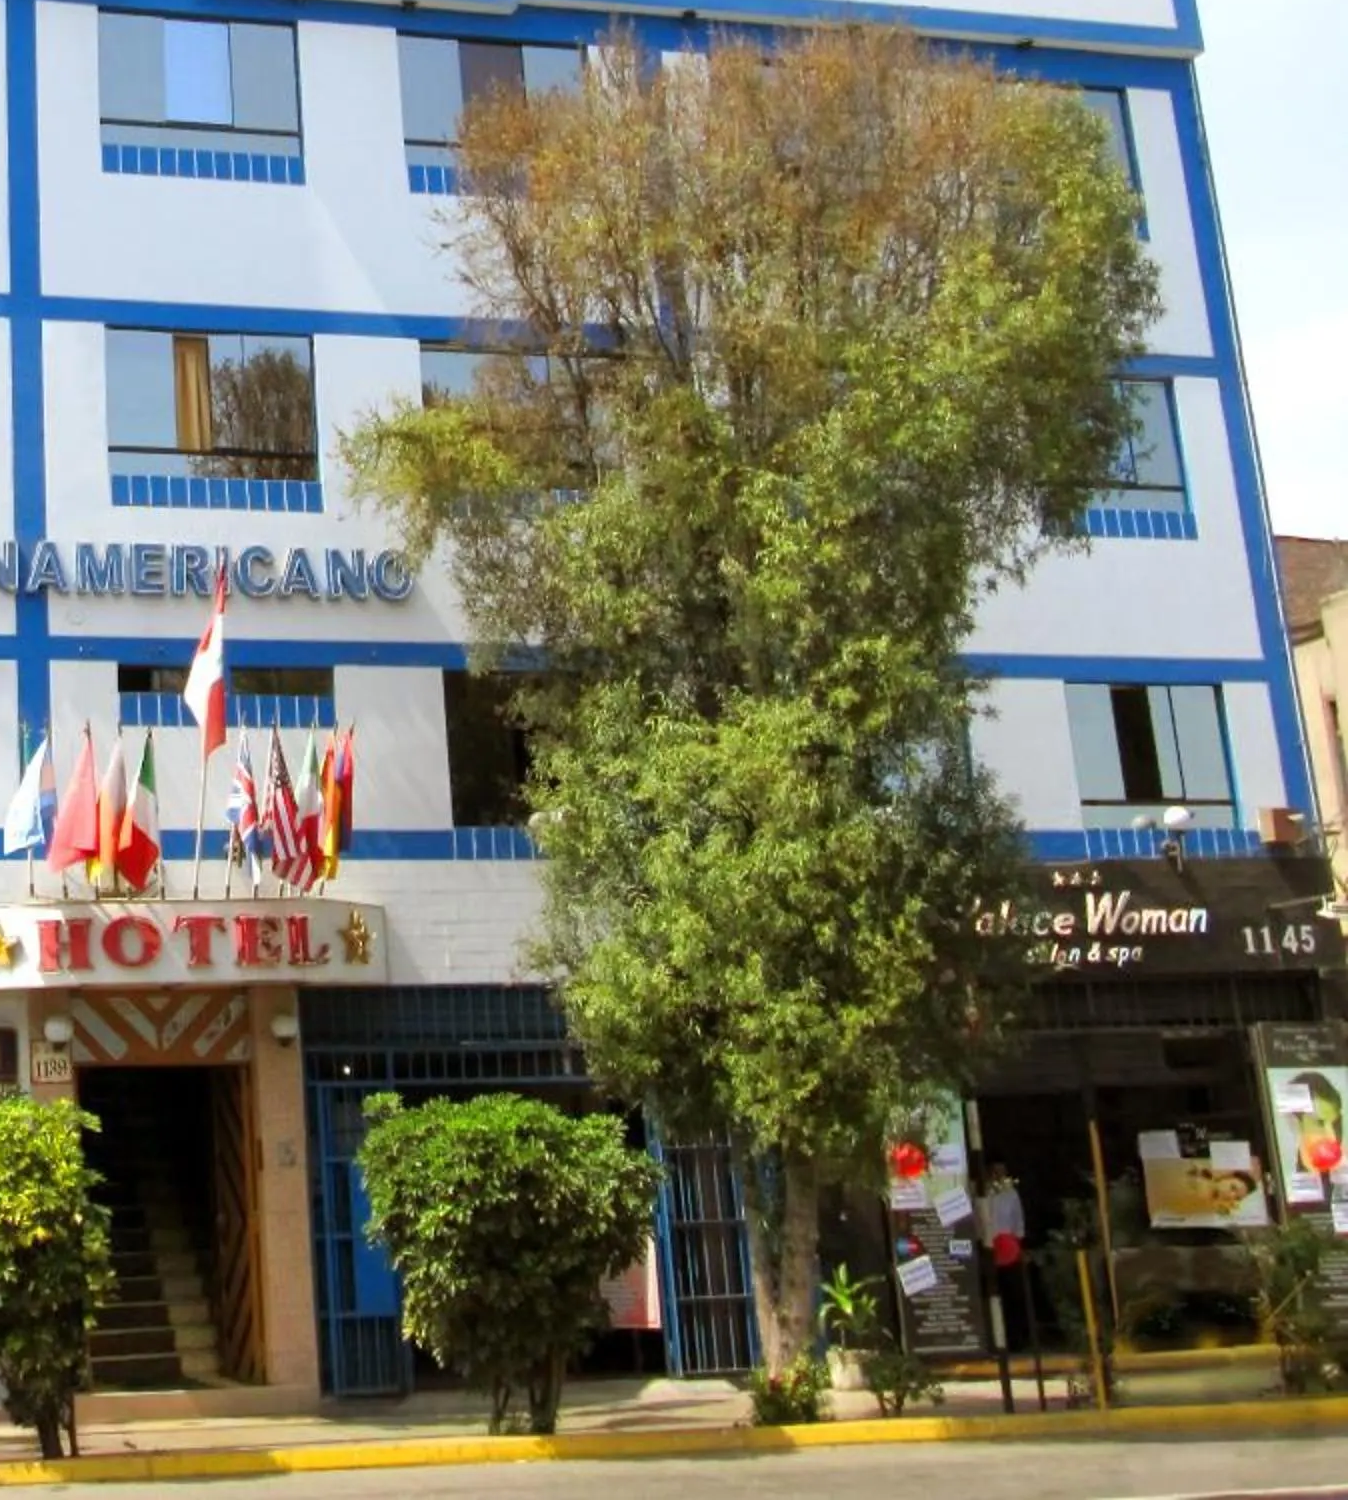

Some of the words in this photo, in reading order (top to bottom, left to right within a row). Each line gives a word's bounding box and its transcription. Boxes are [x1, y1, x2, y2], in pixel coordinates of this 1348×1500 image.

[1085, 889, 1208, 937] Woman
[37, 913, 331, 973] HOTEL
[1087, 941, 1101, 963] &
[1106, 943, 1144, 968] spa
[1243, 923, 1316, 956] 1145
